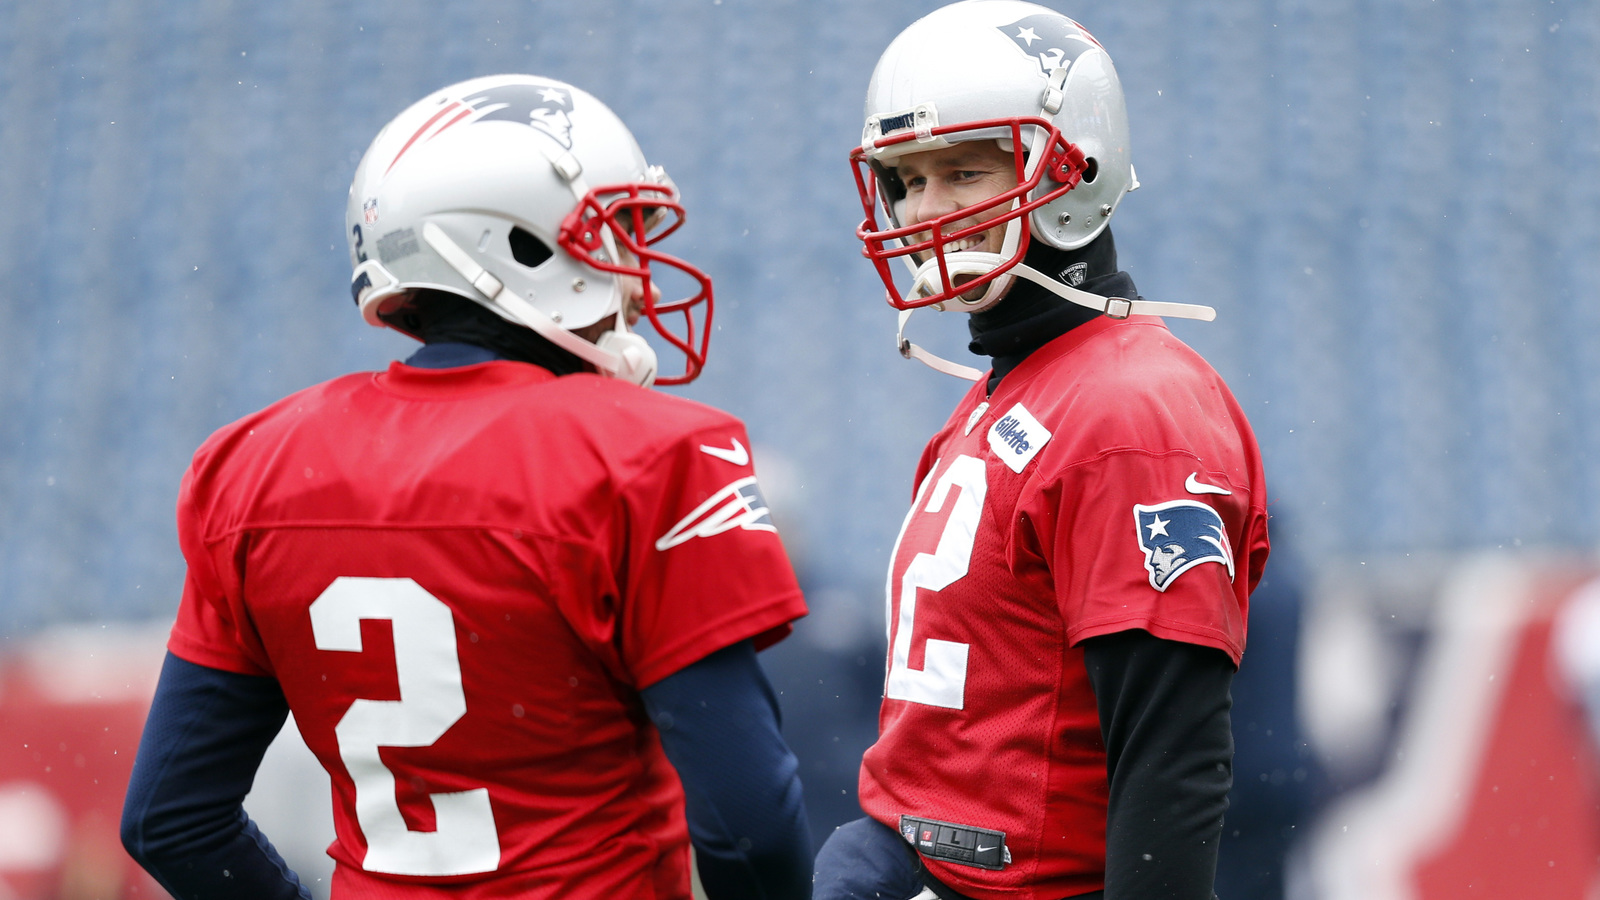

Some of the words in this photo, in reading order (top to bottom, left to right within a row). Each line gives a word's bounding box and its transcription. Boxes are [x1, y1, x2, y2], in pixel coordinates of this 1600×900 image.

[880, 112, 915, 136] ATRIOT
[353, 223, 368, 262] 2
[994, 415, 1030, 455] Gillette
[308, 576, 501, 876] 2
[951, 830, 960, 845] L
